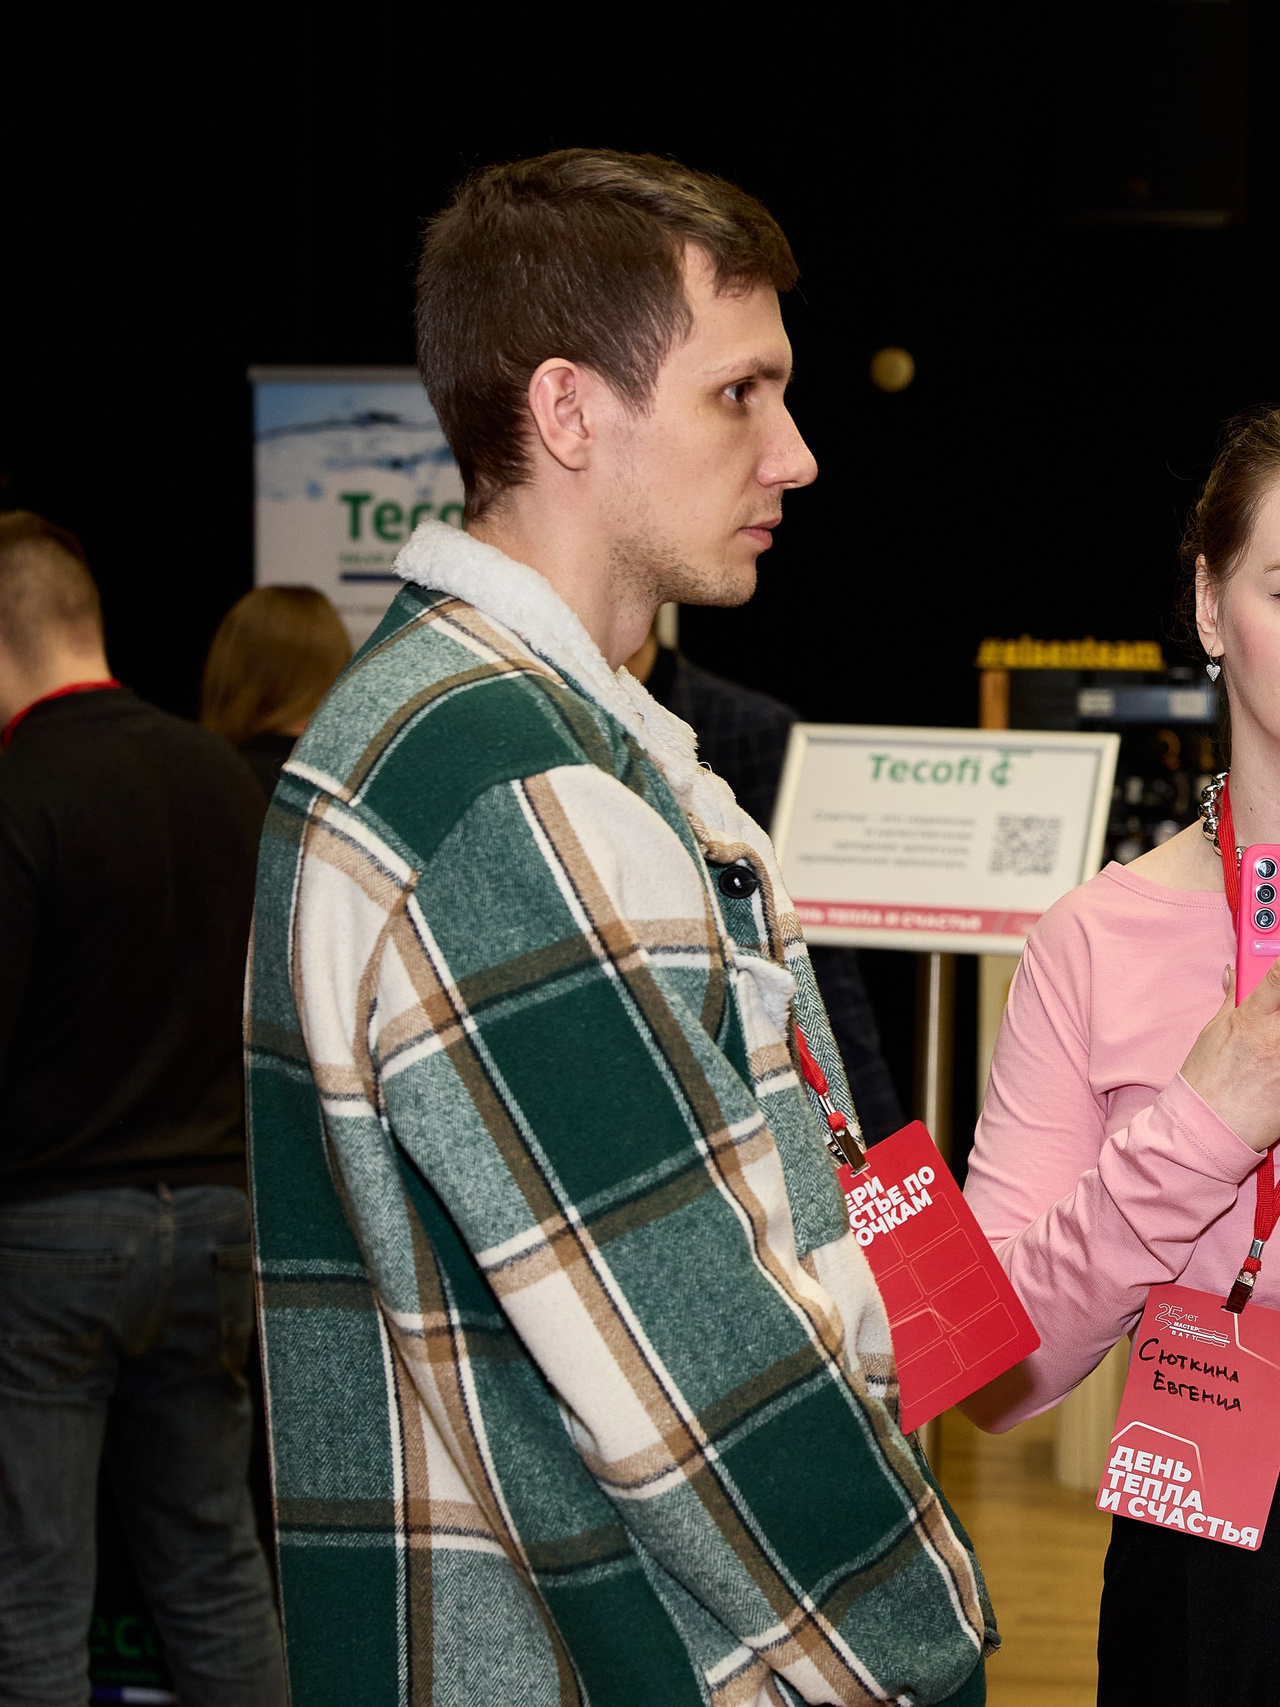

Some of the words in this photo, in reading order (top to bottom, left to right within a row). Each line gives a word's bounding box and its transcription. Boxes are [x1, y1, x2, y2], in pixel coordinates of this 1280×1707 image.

[869, 754, 981, 785] Tecofi
[902, 1165, 936, 1196] ПО
[852, 1188, 934, 1247] ОЧКАМ
[1173, 1321, 1201, 1332] МАСТЕР
[1109, 1445, 1192, 1482] ДЕНЬ
[1107, 1467, 1203, 1512] ТЕПЛА
[1098, 1488, 1122, 1511] И
[1127, 1497, 1260, 1548] СЧАСТЬЯ
